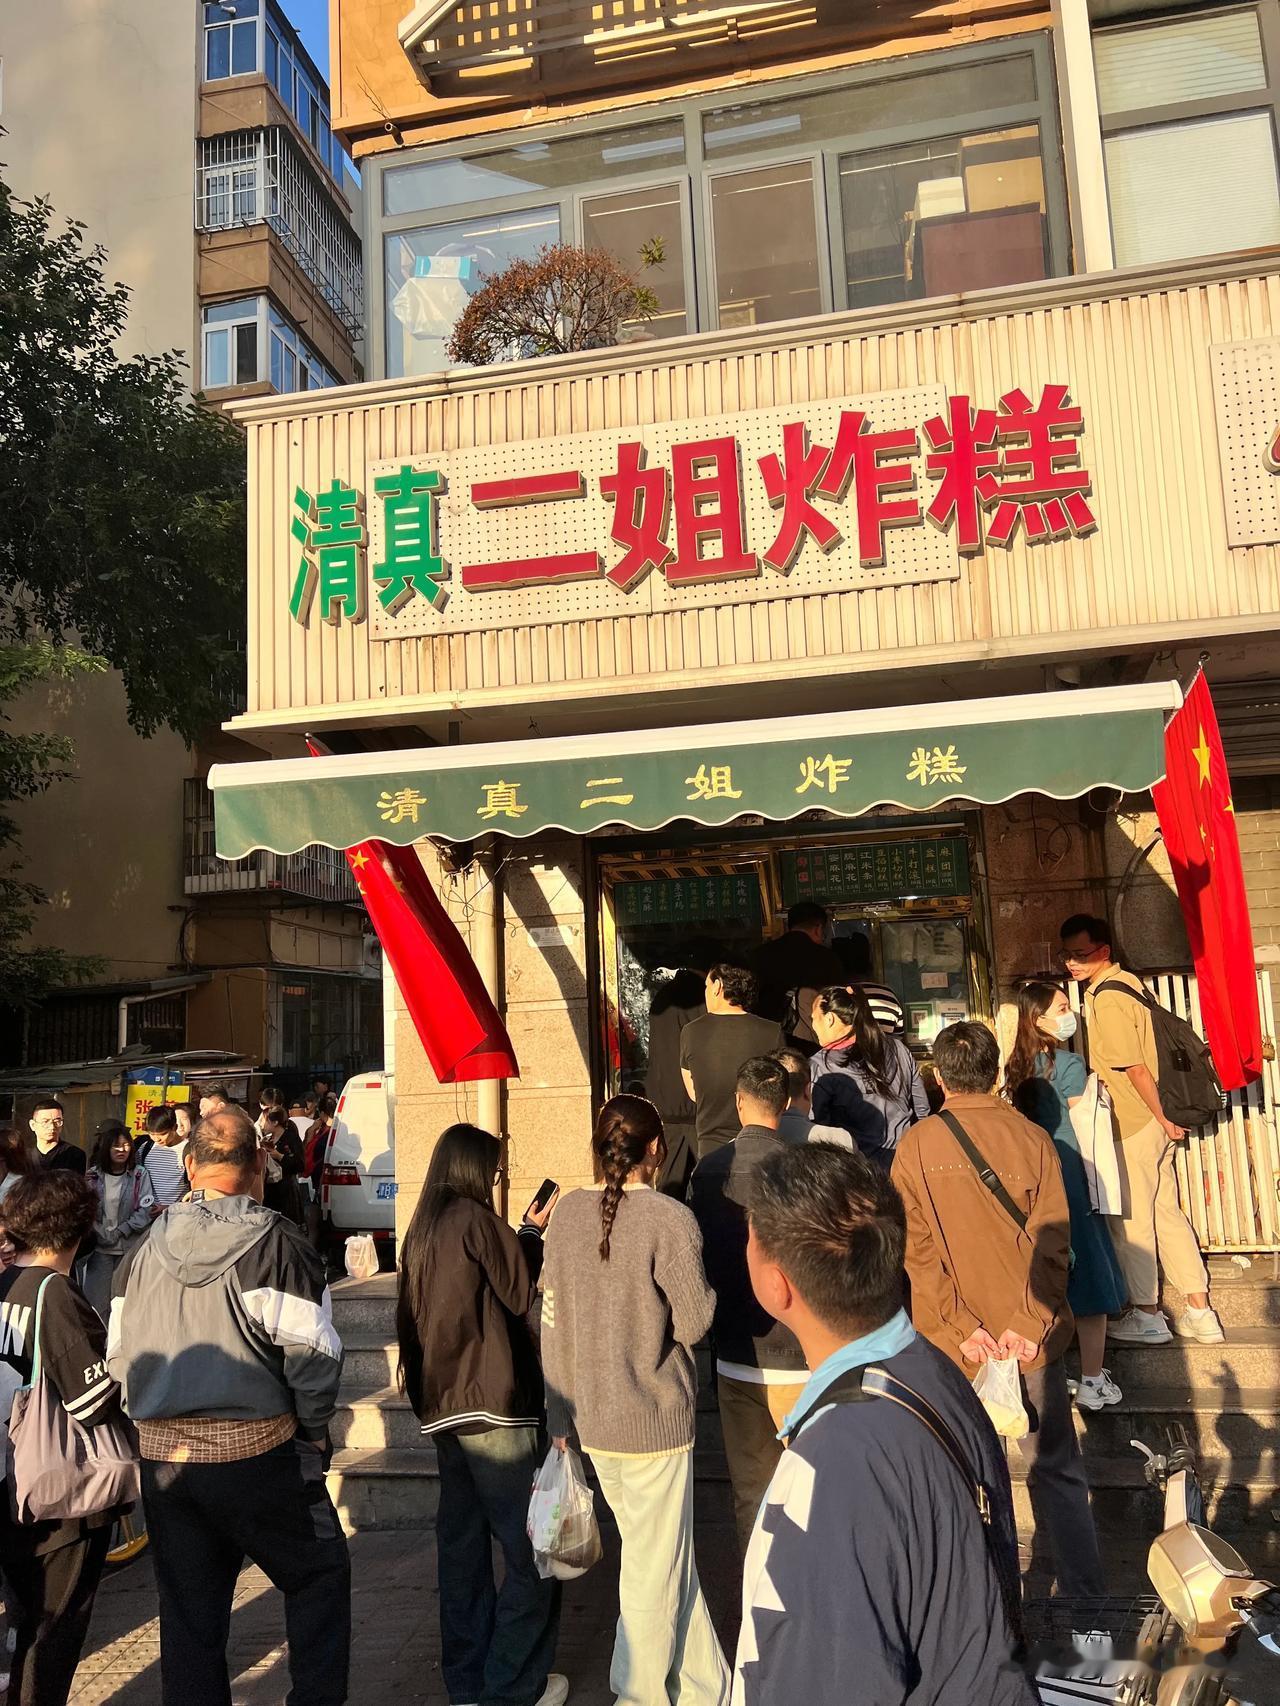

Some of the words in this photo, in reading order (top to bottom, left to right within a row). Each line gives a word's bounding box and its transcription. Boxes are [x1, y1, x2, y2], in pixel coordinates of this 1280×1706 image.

[289, 384, 1096, 627] 清真二姐炸糕
[376, 745, 967, 824] 清真二姐炸糕
